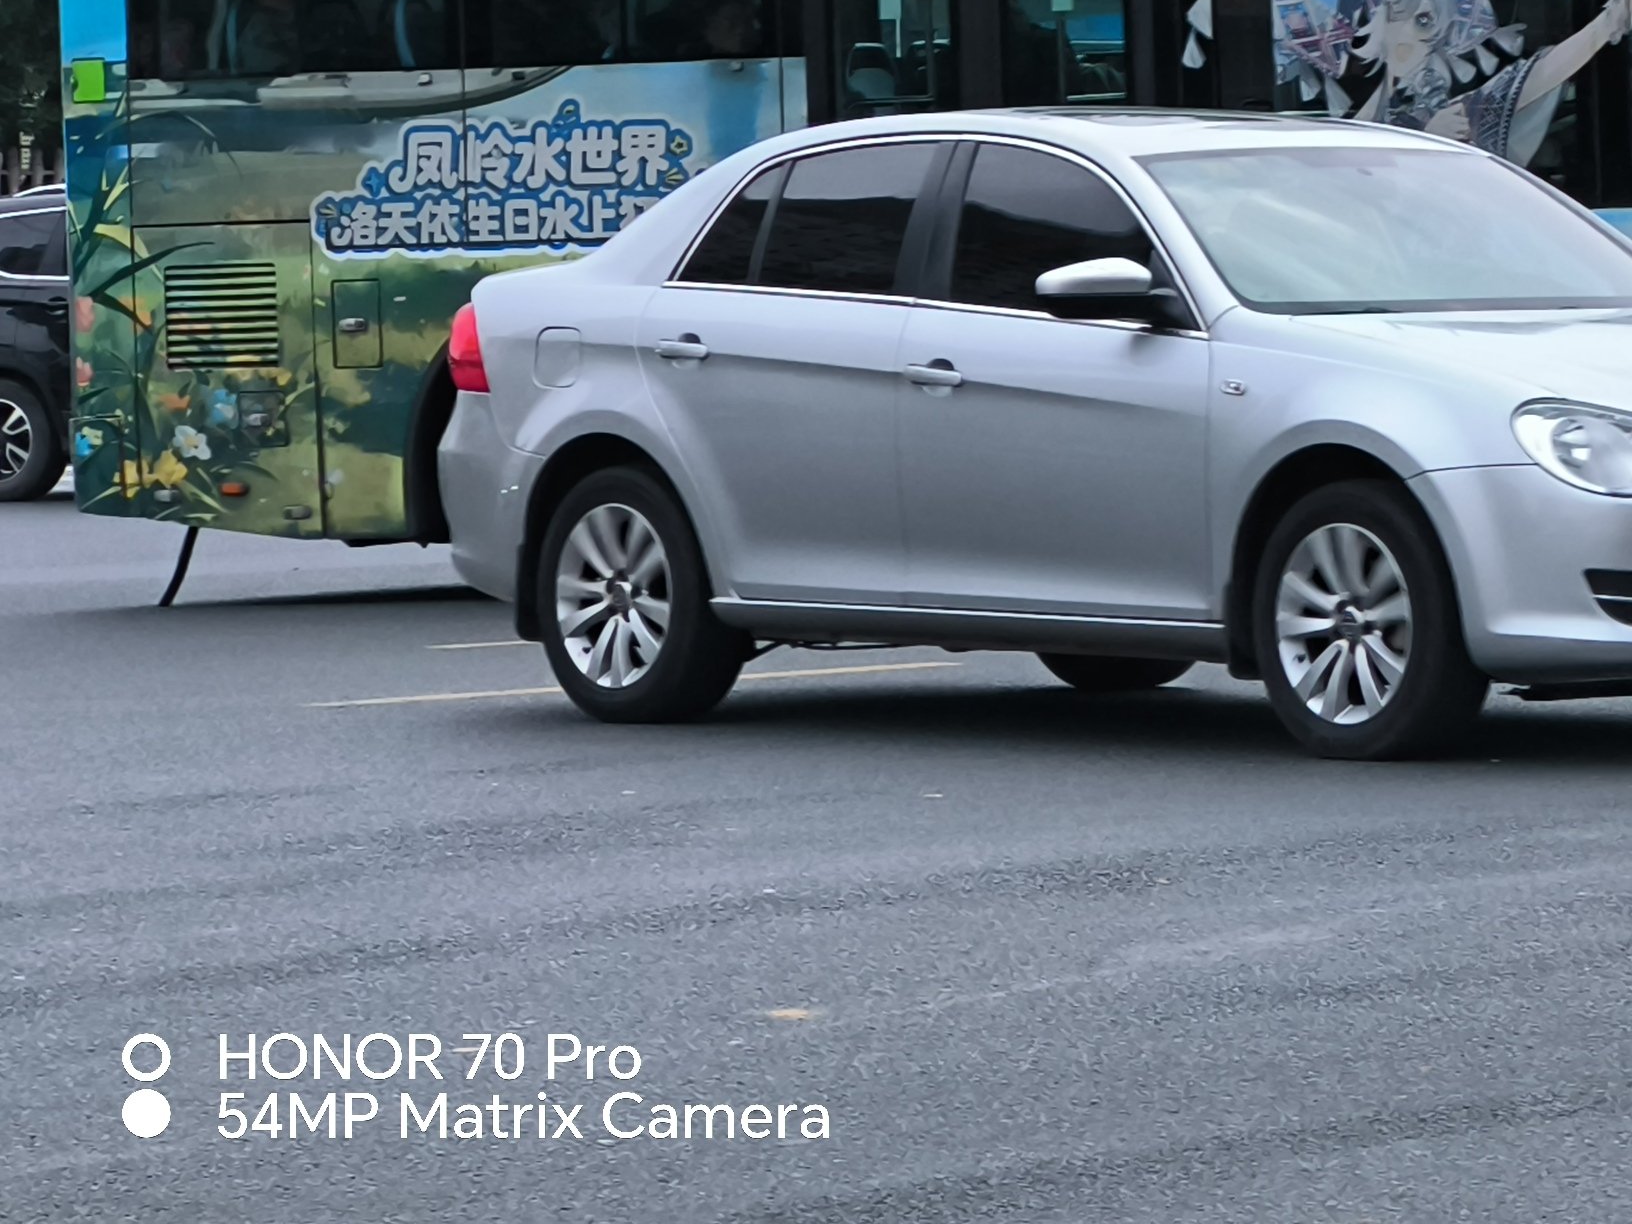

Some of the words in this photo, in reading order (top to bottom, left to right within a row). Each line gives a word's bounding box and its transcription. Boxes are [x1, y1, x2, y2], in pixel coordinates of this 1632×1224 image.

[388, 125, 671, 189] 凤岭水世界
